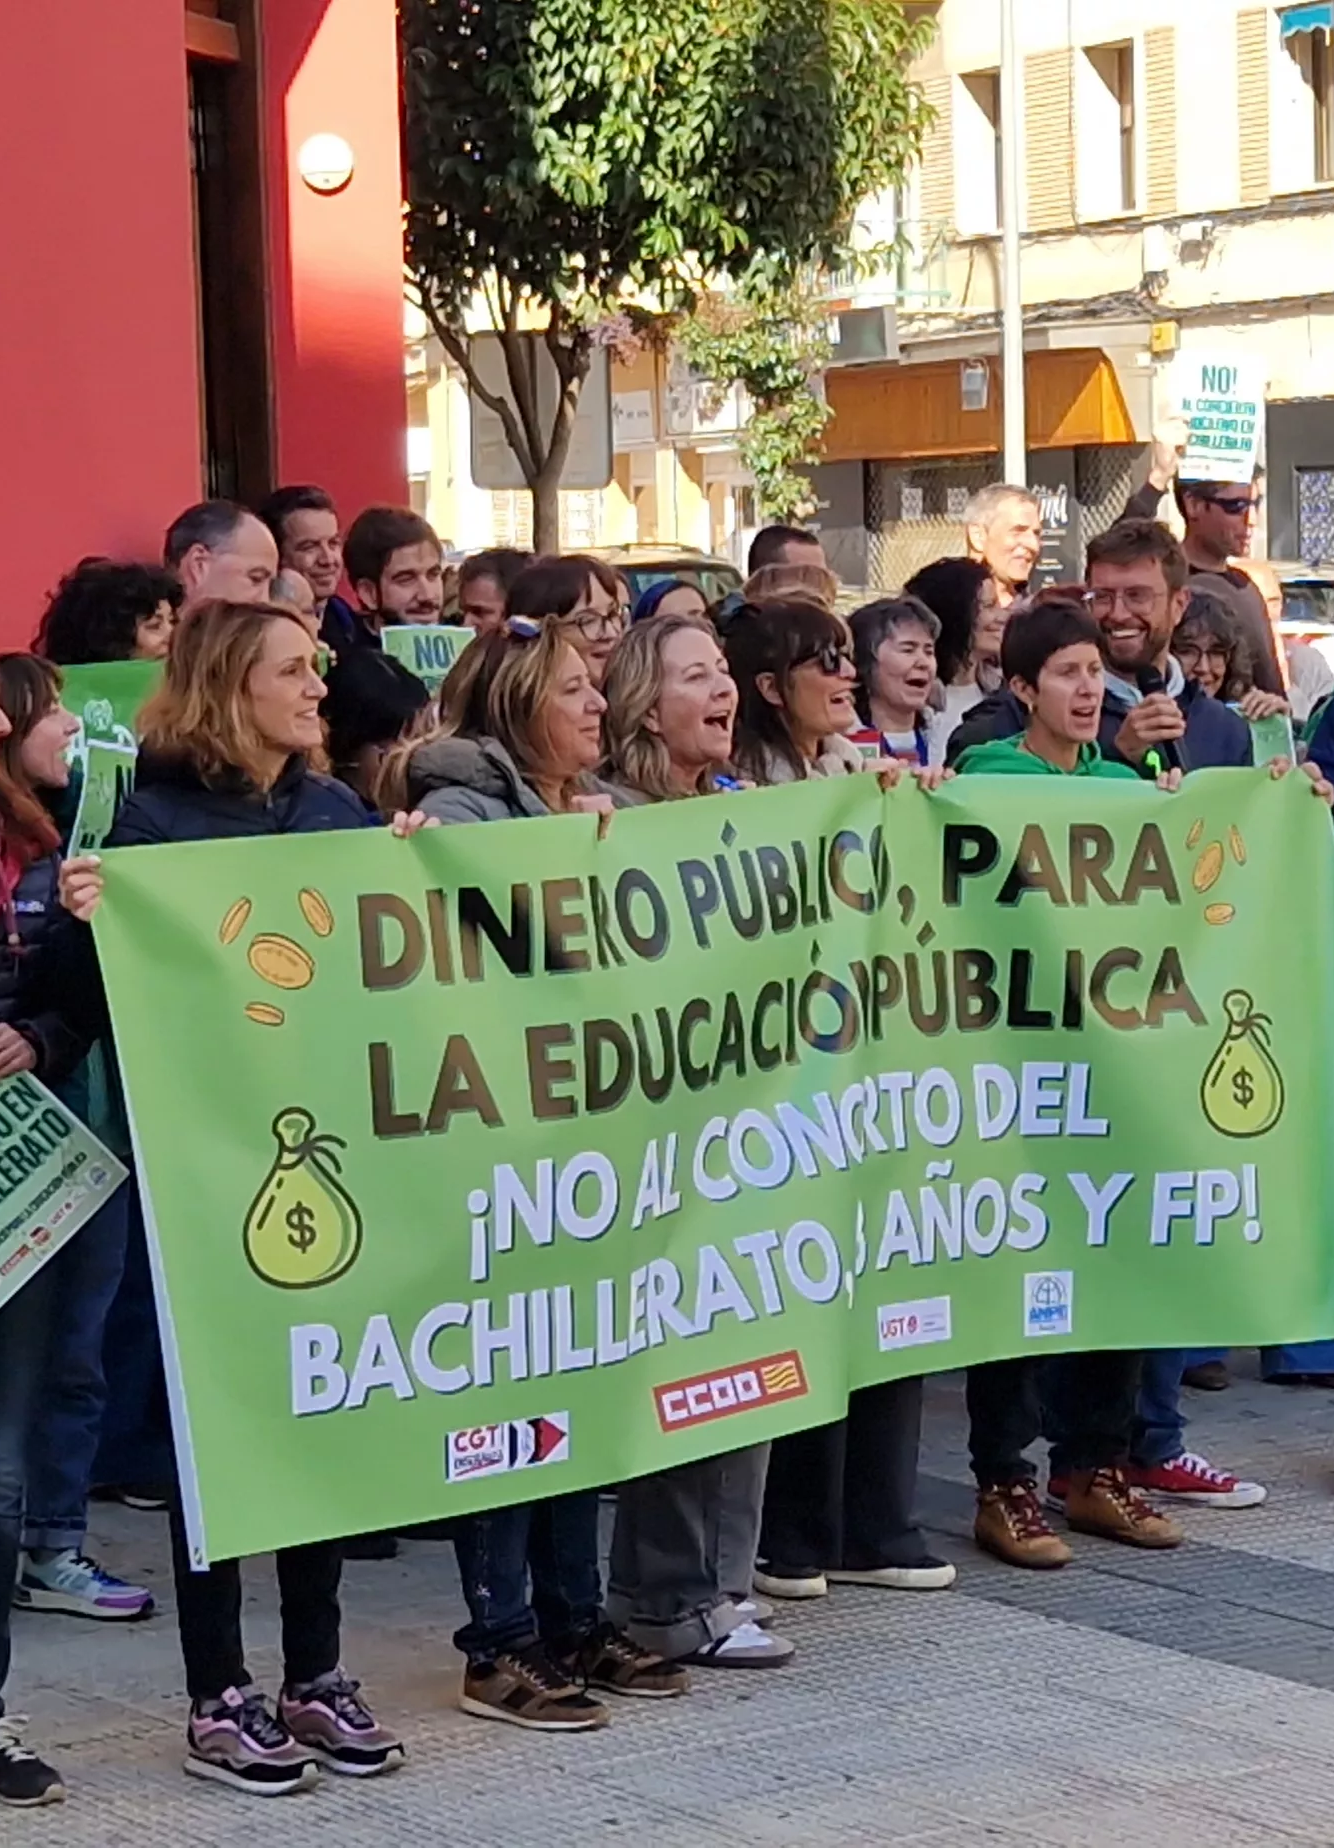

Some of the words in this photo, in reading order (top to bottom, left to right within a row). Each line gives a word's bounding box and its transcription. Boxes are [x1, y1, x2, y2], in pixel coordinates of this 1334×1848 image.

[1202, 365, 1237, 395] NO!
[357, 867, 670, 992] DINERO
[942, 823, 1181, 908] PARA
[368, 1034, 505, 1139] LA
[871, 920, 1208, 1040] PÚBLICA
[8, 1076, 42, 1129] EN
[467, 1151, 620, 1283] ¡NO
[631, 1132, 682, 1231] AL
[973, 1063, 1110, 1141] DEL
[288, 1219, 853, 1416] BACHILLERATO,
[875, 1158, 1049, 1271] AÑOS
[1068, 1172, 1135, 1247] Y
[1150, 1163, 1264, 1245] FP!
[880, 1317, 905, 1338] UGT
[661, 1370, 762, 1423] CCOO
[454, 1425, 499, 1452] CGT
